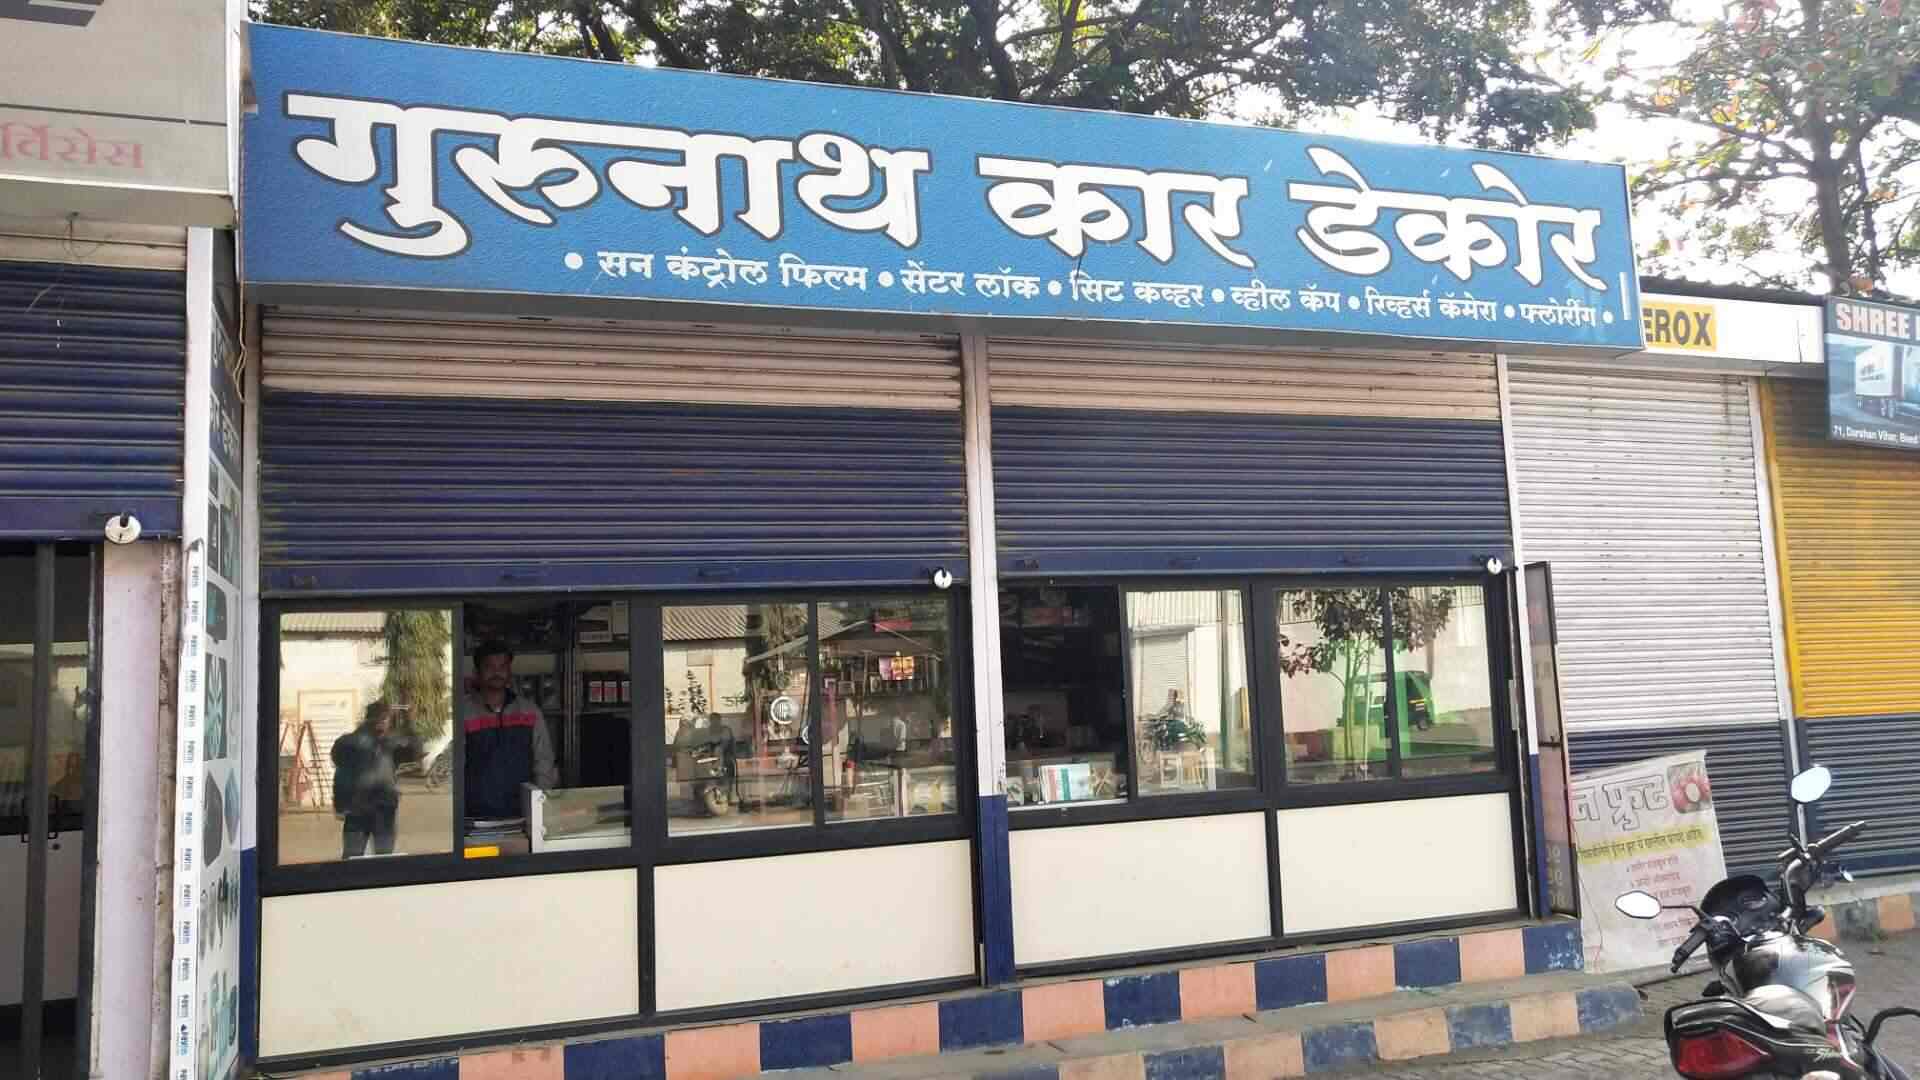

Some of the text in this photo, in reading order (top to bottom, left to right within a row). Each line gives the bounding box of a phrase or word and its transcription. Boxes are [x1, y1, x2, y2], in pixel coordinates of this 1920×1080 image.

[285, 92, 1606, 291] गुरुनाथ कार डेकोर
[597, 250, 655, 279] सन
[665, 246, 769, 289] कंट्रोल
[778, 252, 869, 291] फिल्म
[899, 259, 966, 296] सेंटर
[972, 266, 1041, 300] लॉक
[1068, 269, 1124, 303] सिट
[1131, 280, 1206, 309] कव्हर
[1230, 280, 1292, 313] व्हील
[1298, 283, 1342, 314] कॅप
[1437, 291, 1498, 322] कॅमेरा
[1642, 308, 1712, 346] EROX
[1835, 303, 1910, 338] SHREE
